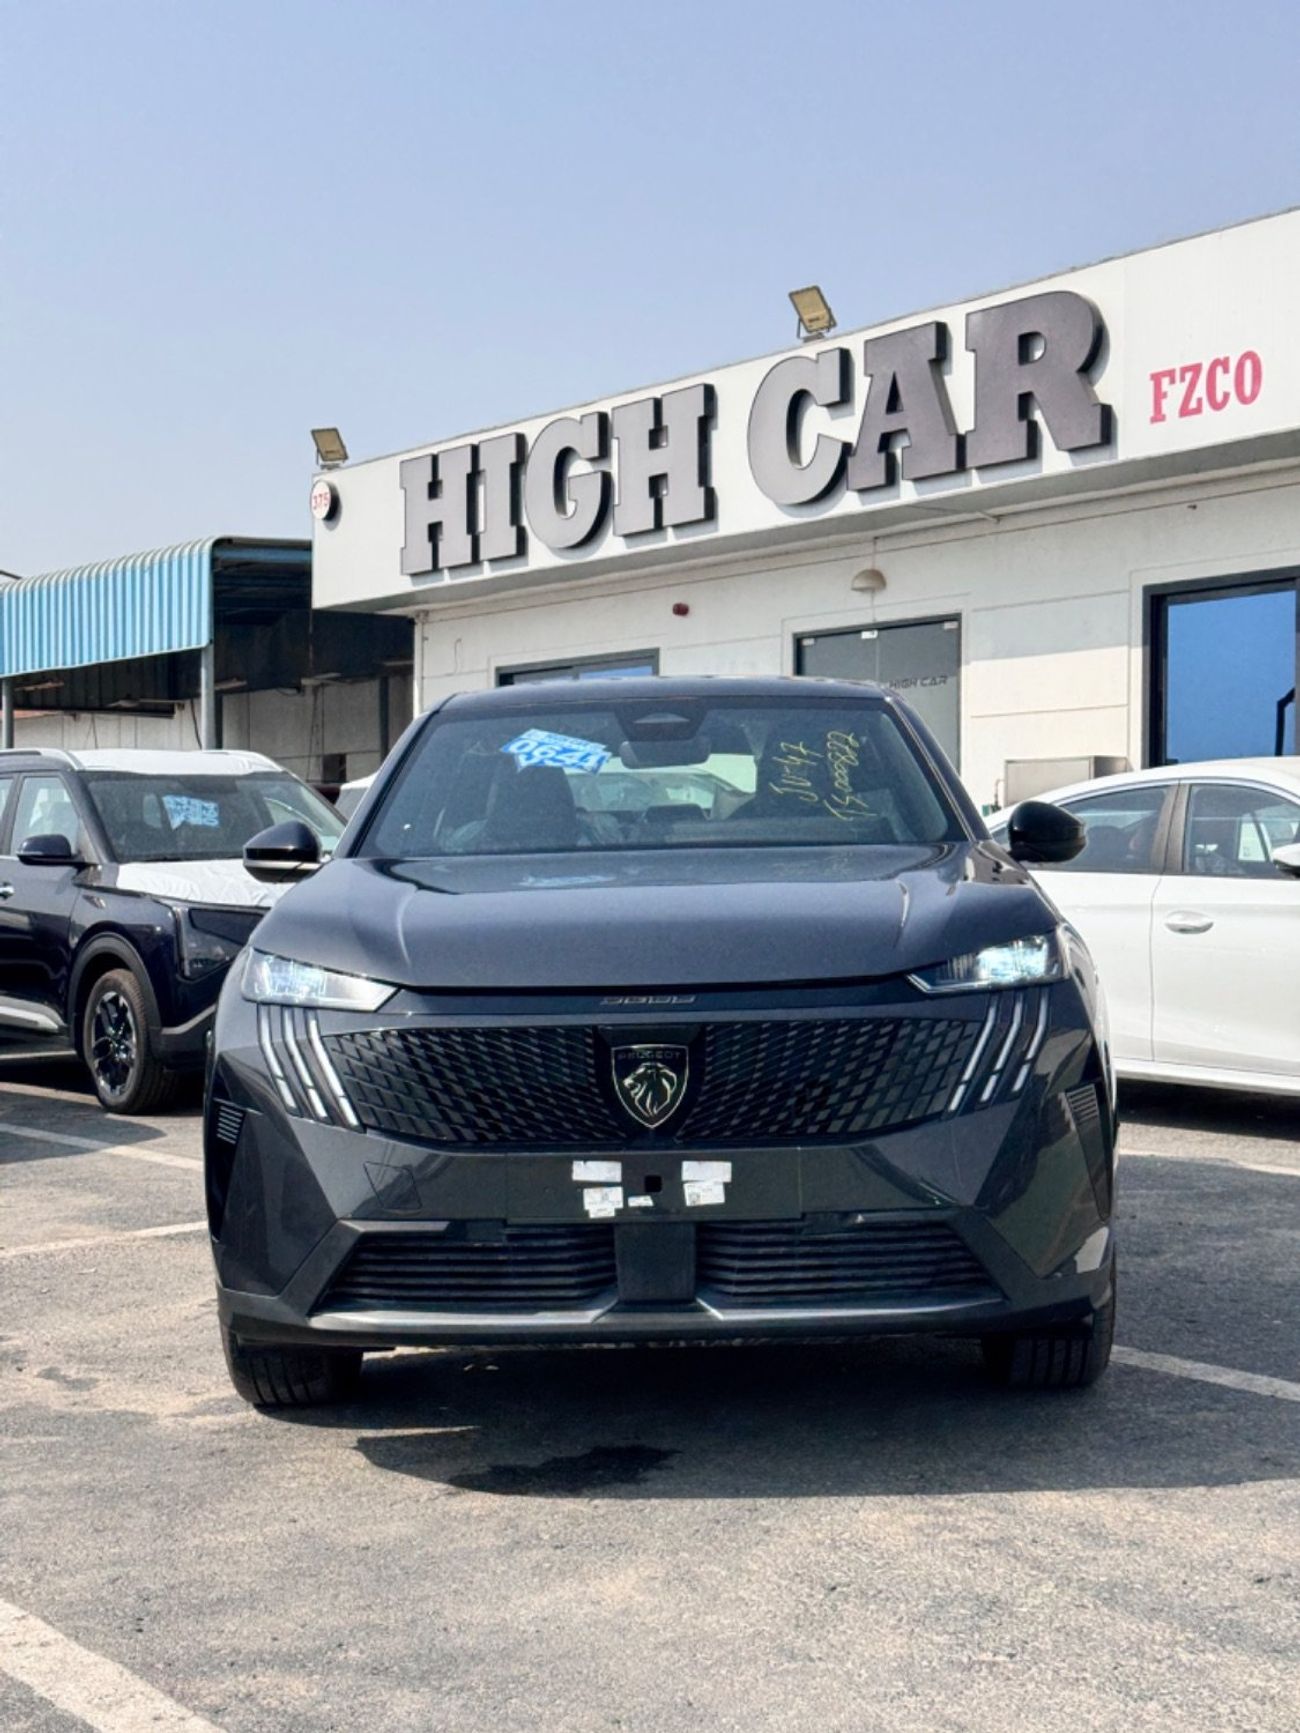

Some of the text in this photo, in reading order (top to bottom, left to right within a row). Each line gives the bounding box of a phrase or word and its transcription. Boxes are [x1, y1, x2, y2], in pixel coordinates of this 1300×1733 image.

[1150, 350, 1262, 424] FZCO
[399, 290, 1113, 576] HIGH CAR
[888, 675, 948, 690] HIGH CAR
